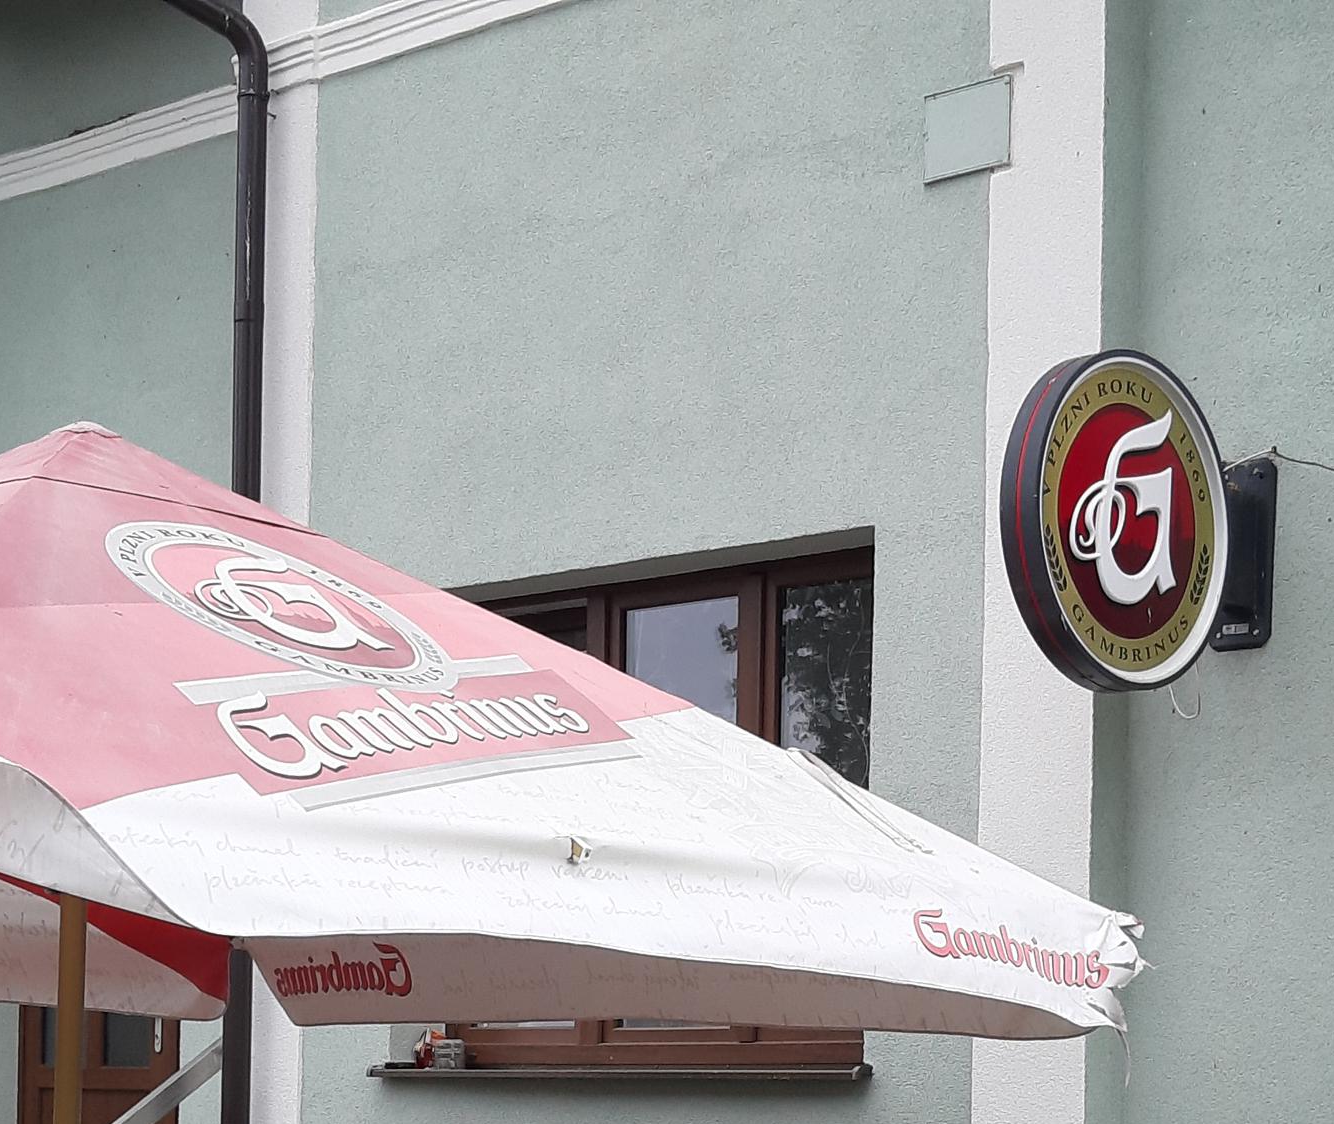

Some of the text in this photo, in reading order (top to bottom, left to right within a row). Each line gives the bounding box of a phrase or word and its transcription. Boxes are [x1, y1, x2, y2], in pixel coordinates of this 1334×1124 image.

[1040, 378, 1206, 503] V PLZNI ROKU 1869
[118, 530, 154, 563] PLZNI
[157, 527, 245, 548] ROKU
[252, 638, 446, 686] GAMBRINUS
[1071, 602, 1191, 664] GAMBRINUS
[216, 688, 590, 780] Gambrinus
[913, 908, 1111, 990] Gambrinus
